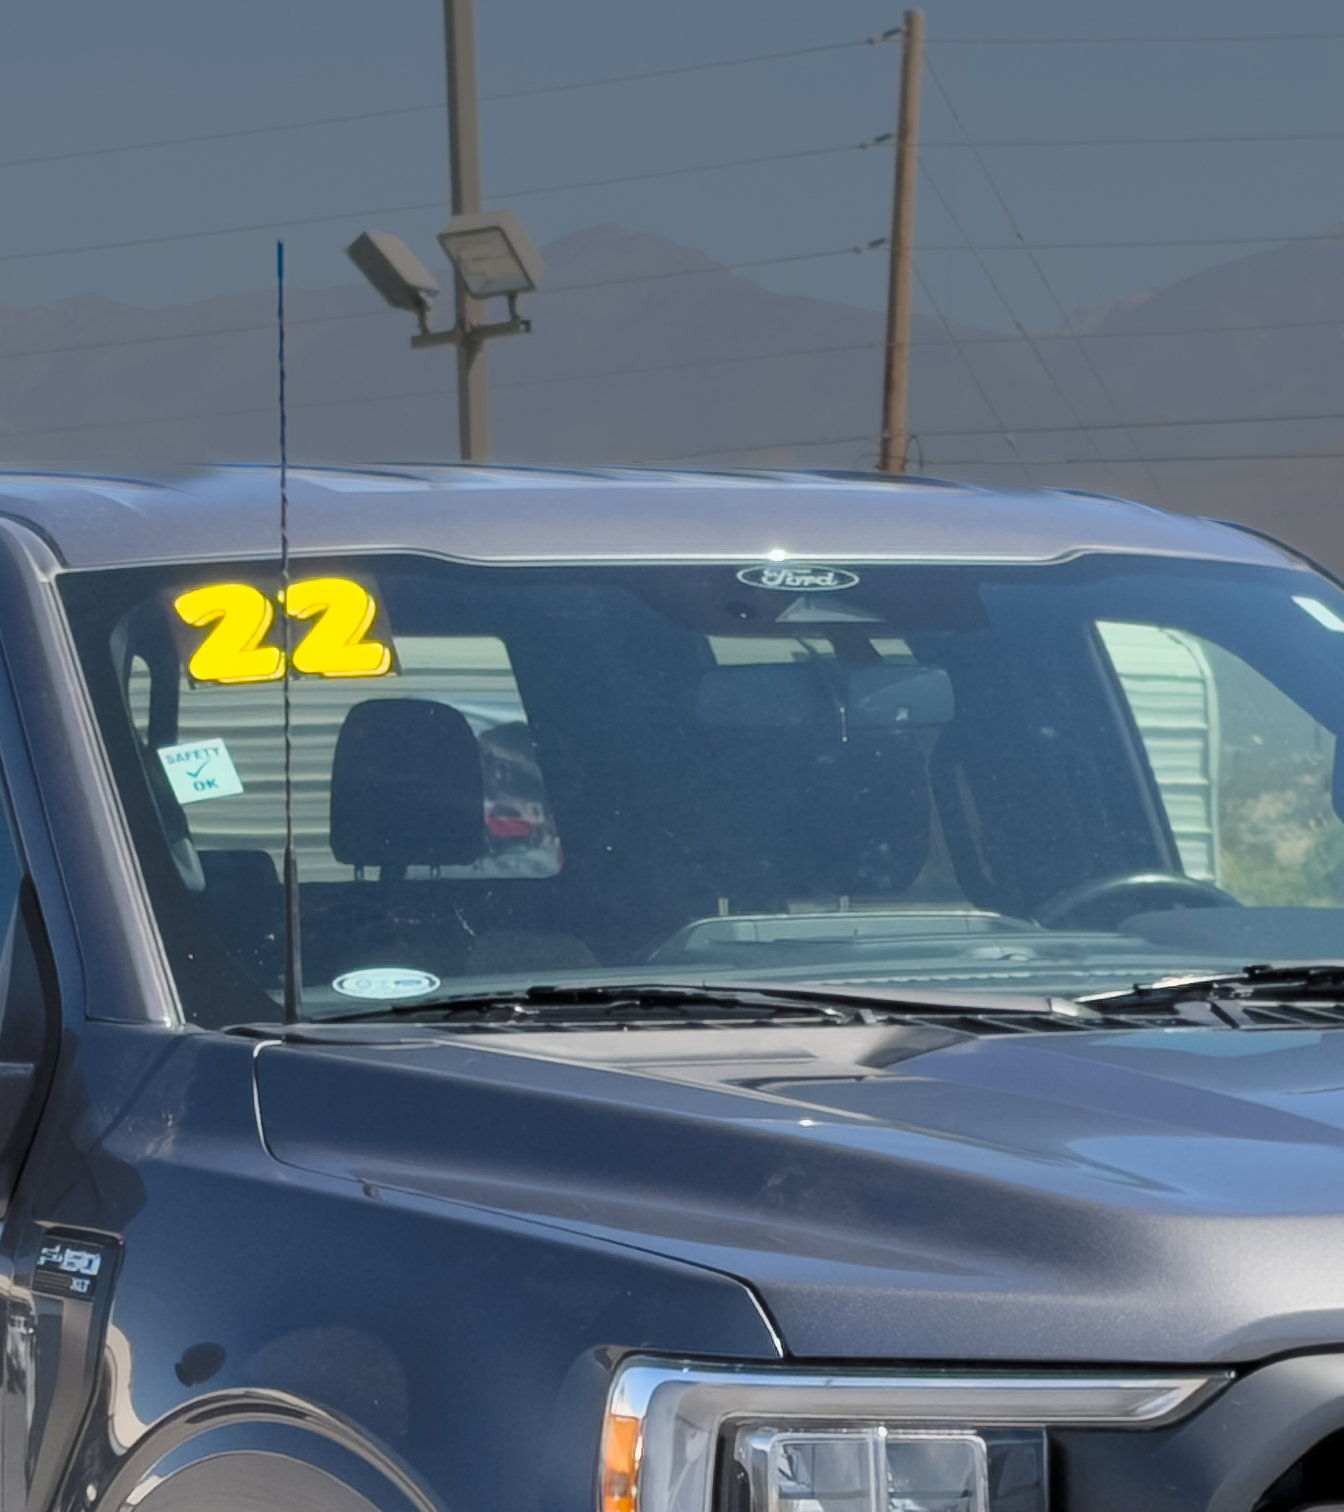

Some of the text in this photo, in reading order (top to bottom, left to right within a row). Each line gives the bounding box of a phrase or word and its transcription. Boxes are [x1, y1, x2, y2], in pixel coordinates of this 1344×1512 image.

[761, 568, 838, 587] Ford
[174, 577, 392, 684] 22
[166, 747, 220, 764] SAFETY
[193, 779, 219, 792] OK
